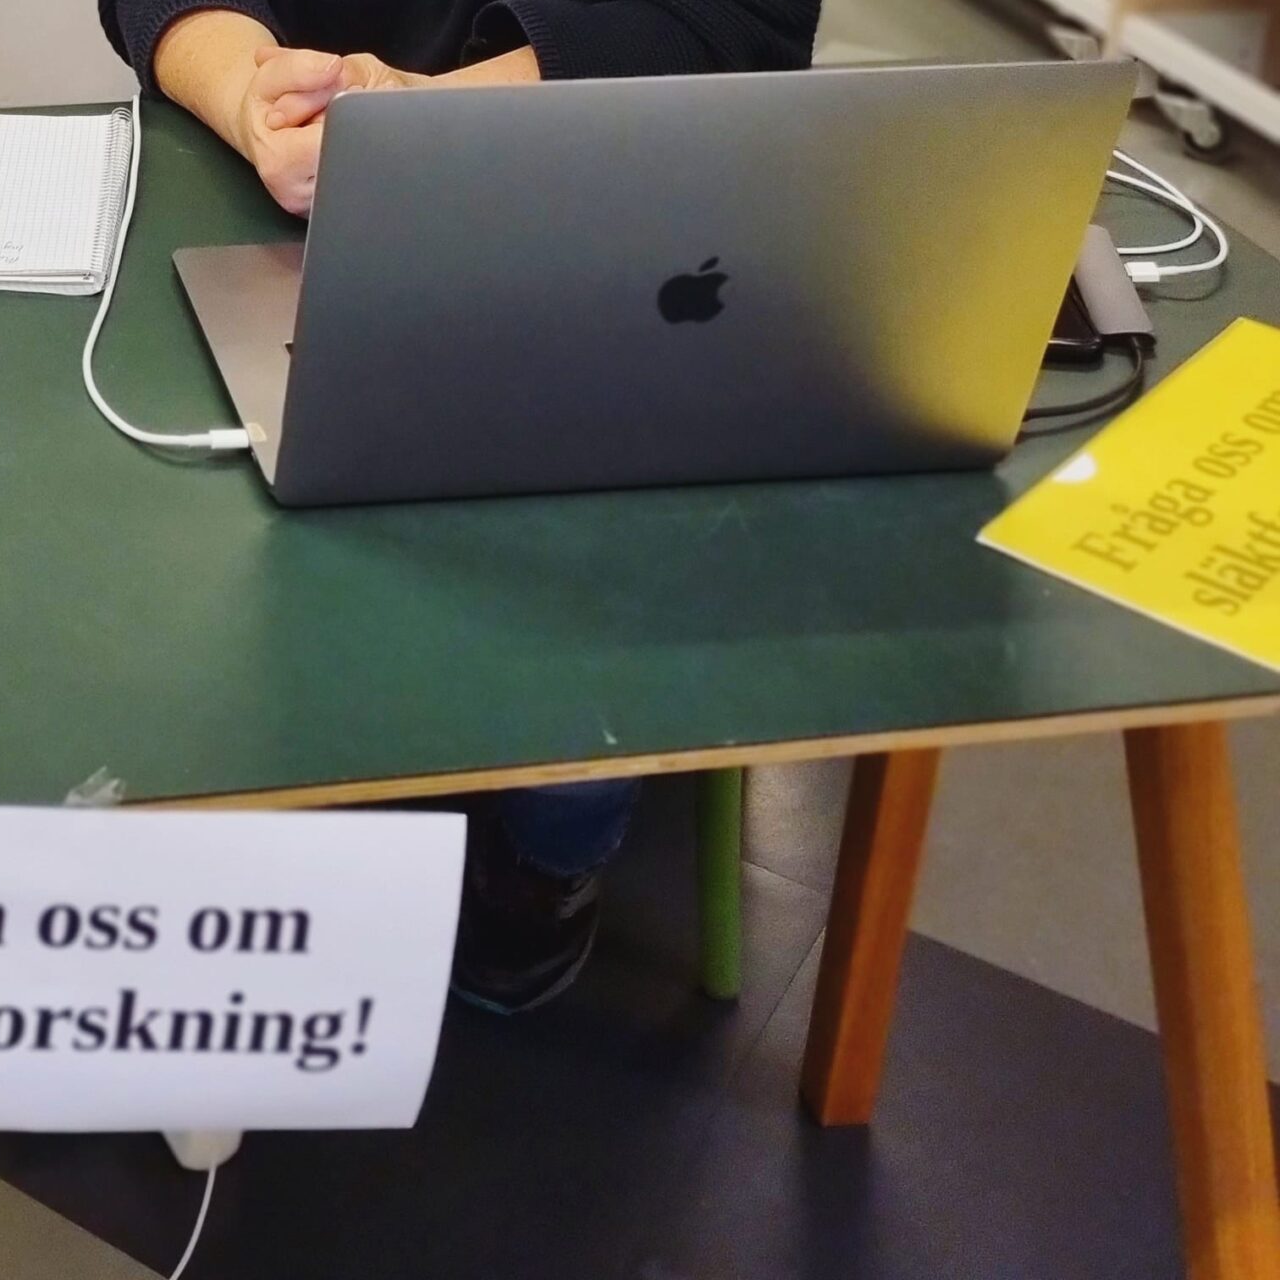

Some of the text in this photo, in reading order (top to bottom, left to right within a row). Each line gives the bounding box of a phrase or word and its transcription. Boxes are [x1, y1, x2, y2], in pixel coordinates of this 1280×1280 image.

[1070, 477, 1217, 574] Fråga
[1192, 431, 1265, 480] oss
[36, 903, 159, 952] oss
[186, 906, 311, 955] om
